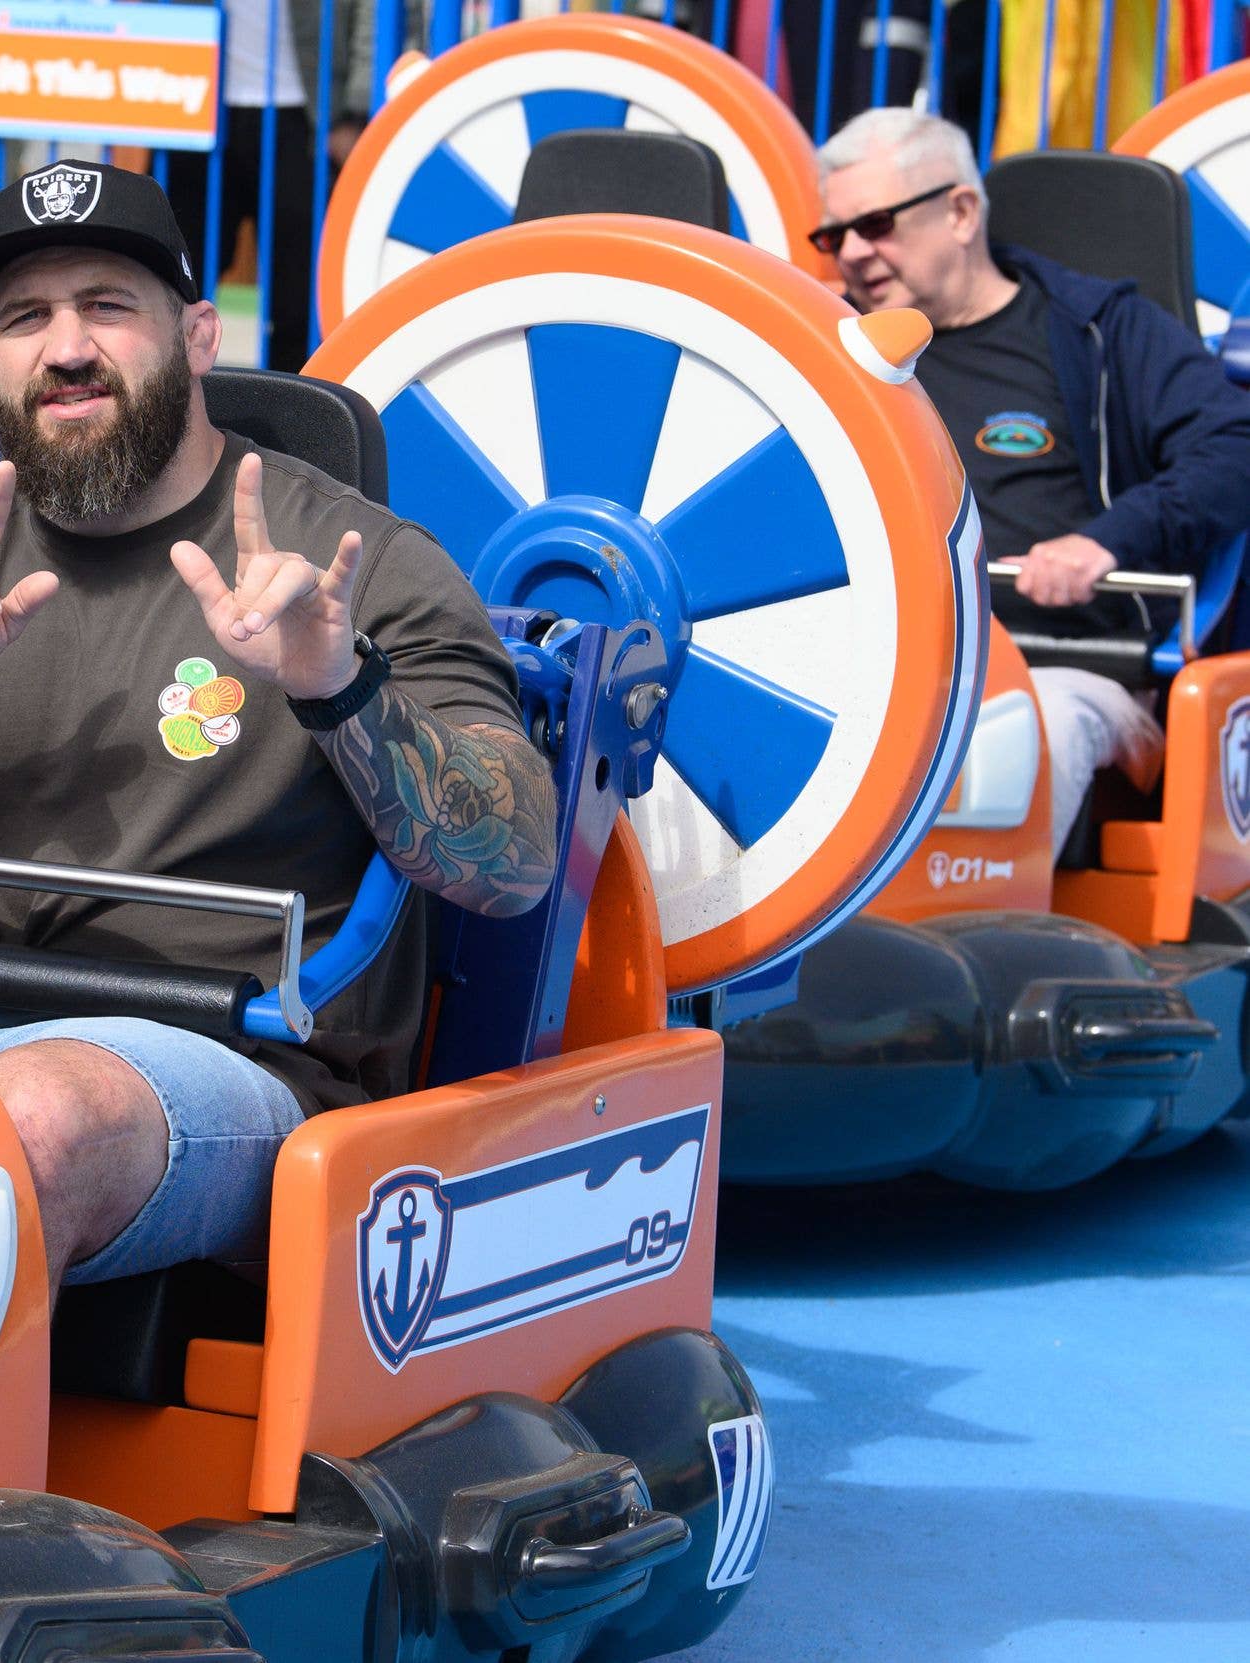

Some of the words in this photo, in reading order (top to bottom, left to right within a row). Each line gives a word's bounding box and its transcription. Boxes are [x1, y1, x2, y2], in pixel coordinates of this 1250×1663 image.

[34, 58, 115, 100] This
[119, 65, 209, 115] Way
[32, 173, 91, 187] RAIDERS
[950, 857, 983, 883] 01
[625, 1209, 671, 1266] 09
